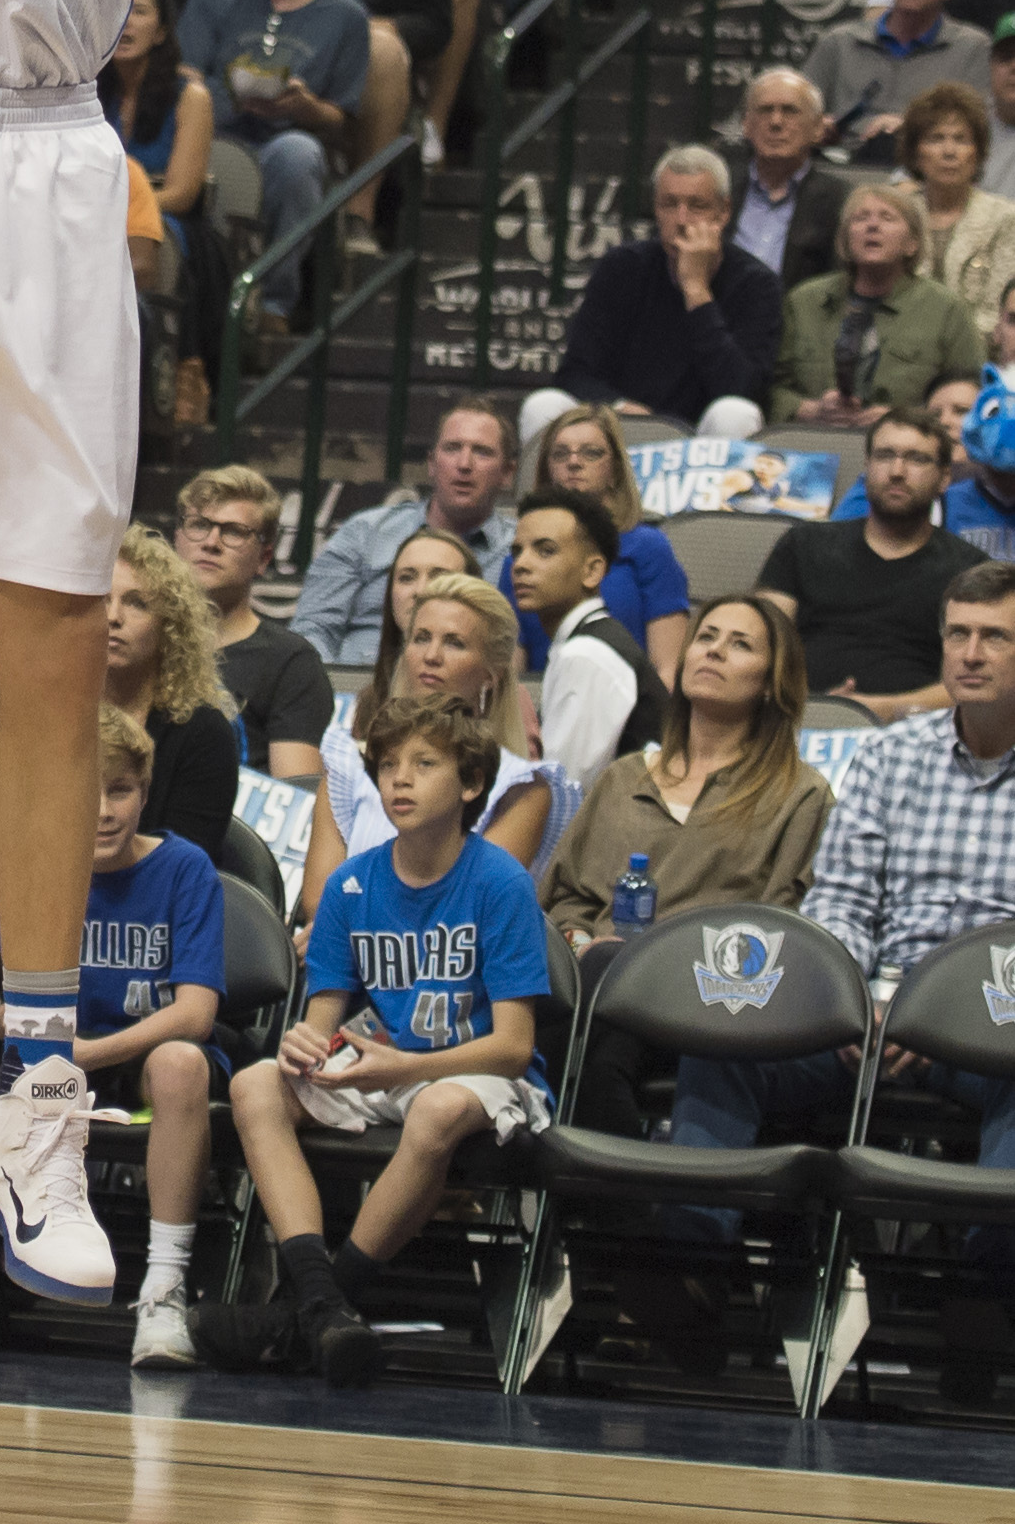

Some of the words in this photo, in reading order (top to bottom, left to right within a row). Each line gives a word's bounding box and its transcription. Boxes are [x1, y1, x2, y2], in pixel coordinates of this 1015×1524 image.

[636, 470, 723, 515] AVS
[410, 989, 475, 1048] 41
[31, 1084, 65, 1098] DIRK
